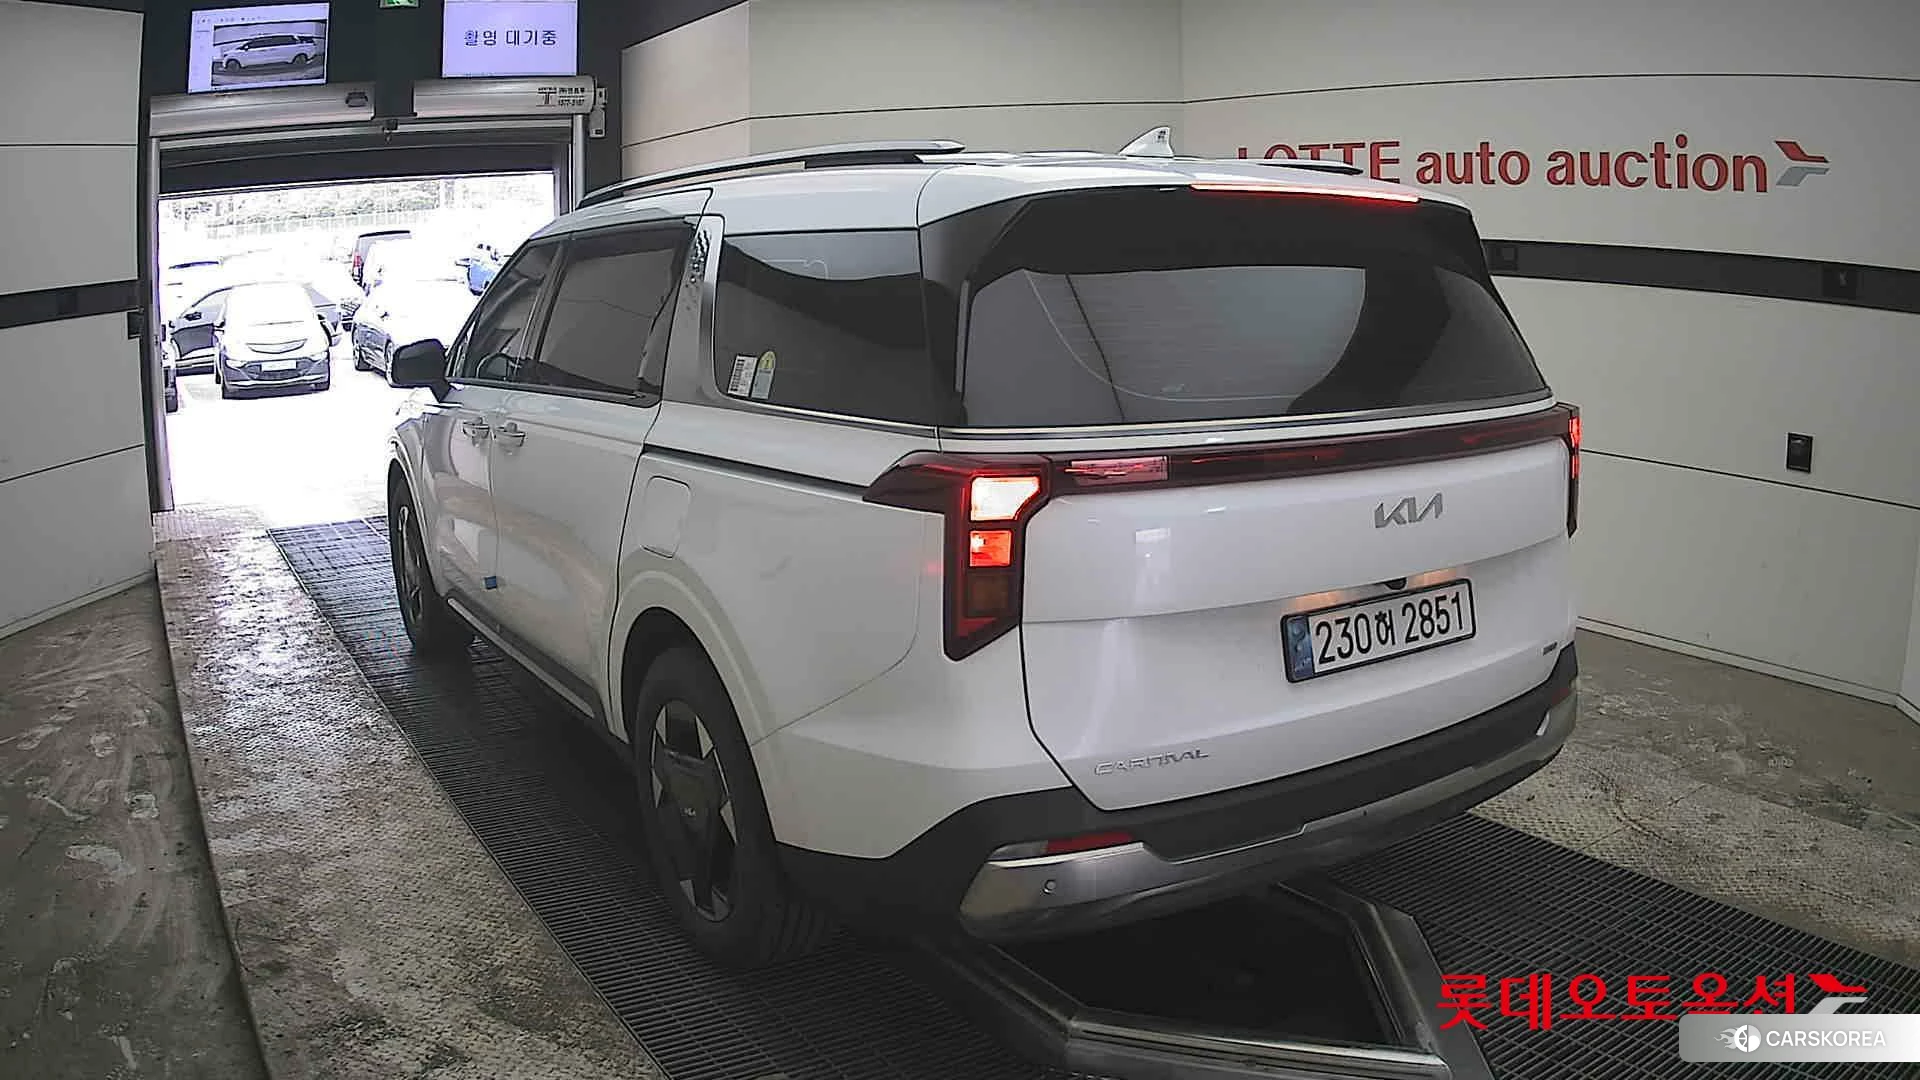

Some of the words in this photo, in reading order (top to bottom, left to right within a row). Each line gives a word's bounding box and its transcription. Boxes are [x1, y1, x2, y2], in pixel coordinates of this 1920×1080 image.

[505, 29, 557, 46] 대기중
[1416, 141, 1531, 185] auto
[1546, 133, 1769, 193] auction
[1374, 491, 1444, 529] KIA
[1314, 611, 1396, 665] 230허
[1401, 590, 1464, 644] 2851
